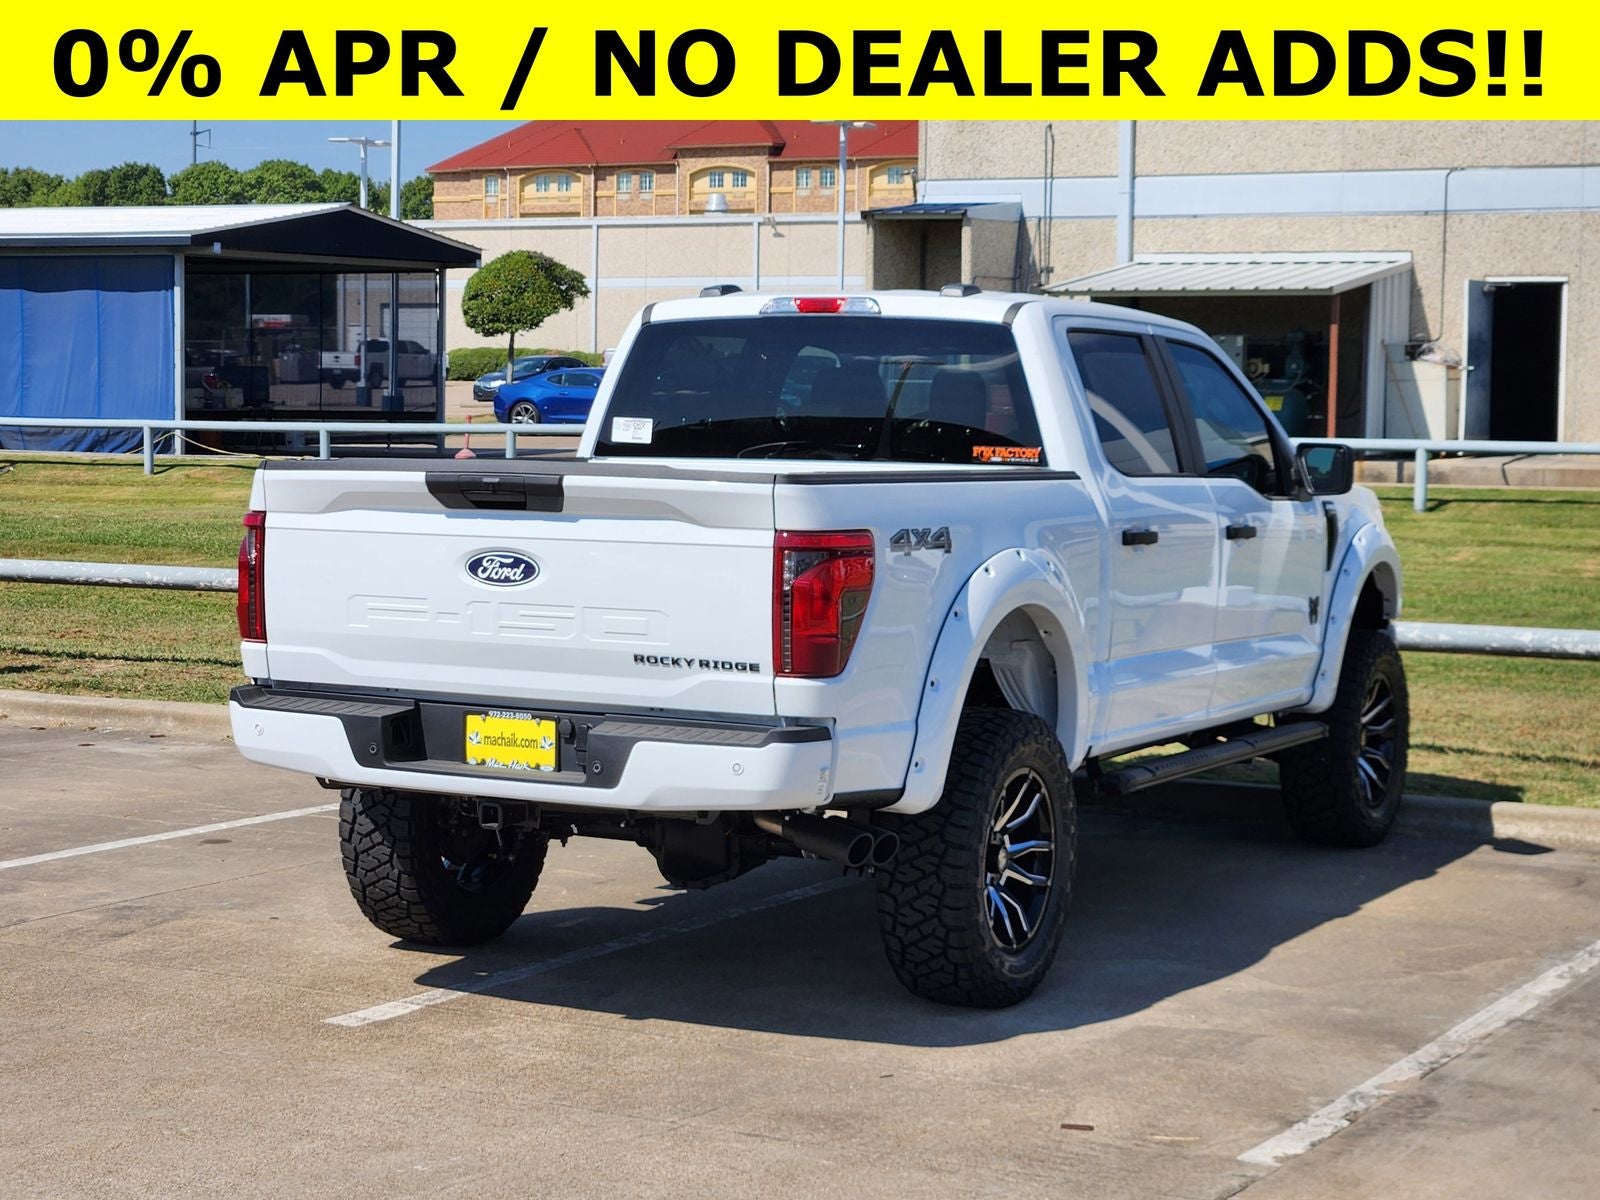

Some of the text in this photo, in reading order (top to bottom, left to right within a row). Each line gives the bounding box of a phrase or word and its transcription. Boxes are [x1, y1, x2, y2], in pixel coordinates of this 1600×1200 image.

[972, 446, 1042, 461] FOX FACTORY
[477, 555, 526, 582] Ford
[347, 594, 671, 646] F-150
[633, 653, 761, 673] ROCKY RIDGE
[484, 732, 538, 749] machaik.com
